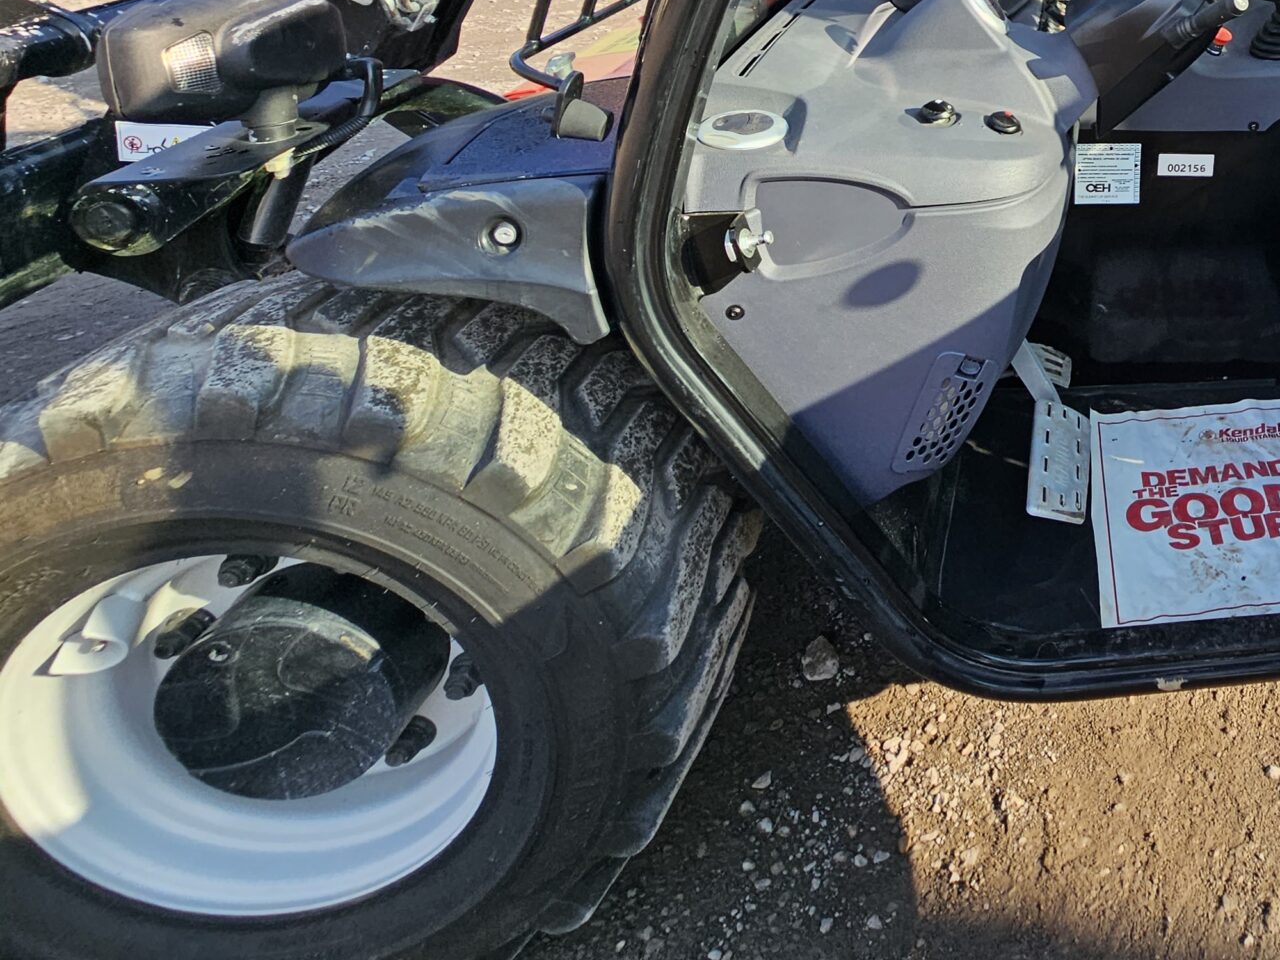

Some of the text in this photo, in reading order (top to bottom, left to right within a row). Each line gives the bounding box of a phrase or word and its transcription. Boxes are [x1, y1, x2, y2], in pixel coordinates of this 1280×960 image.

[1167, 163, 1206, 173] 002156
[1085, 183, 1111, 193] OEH
[1132, 486, 1179, 499] THE
